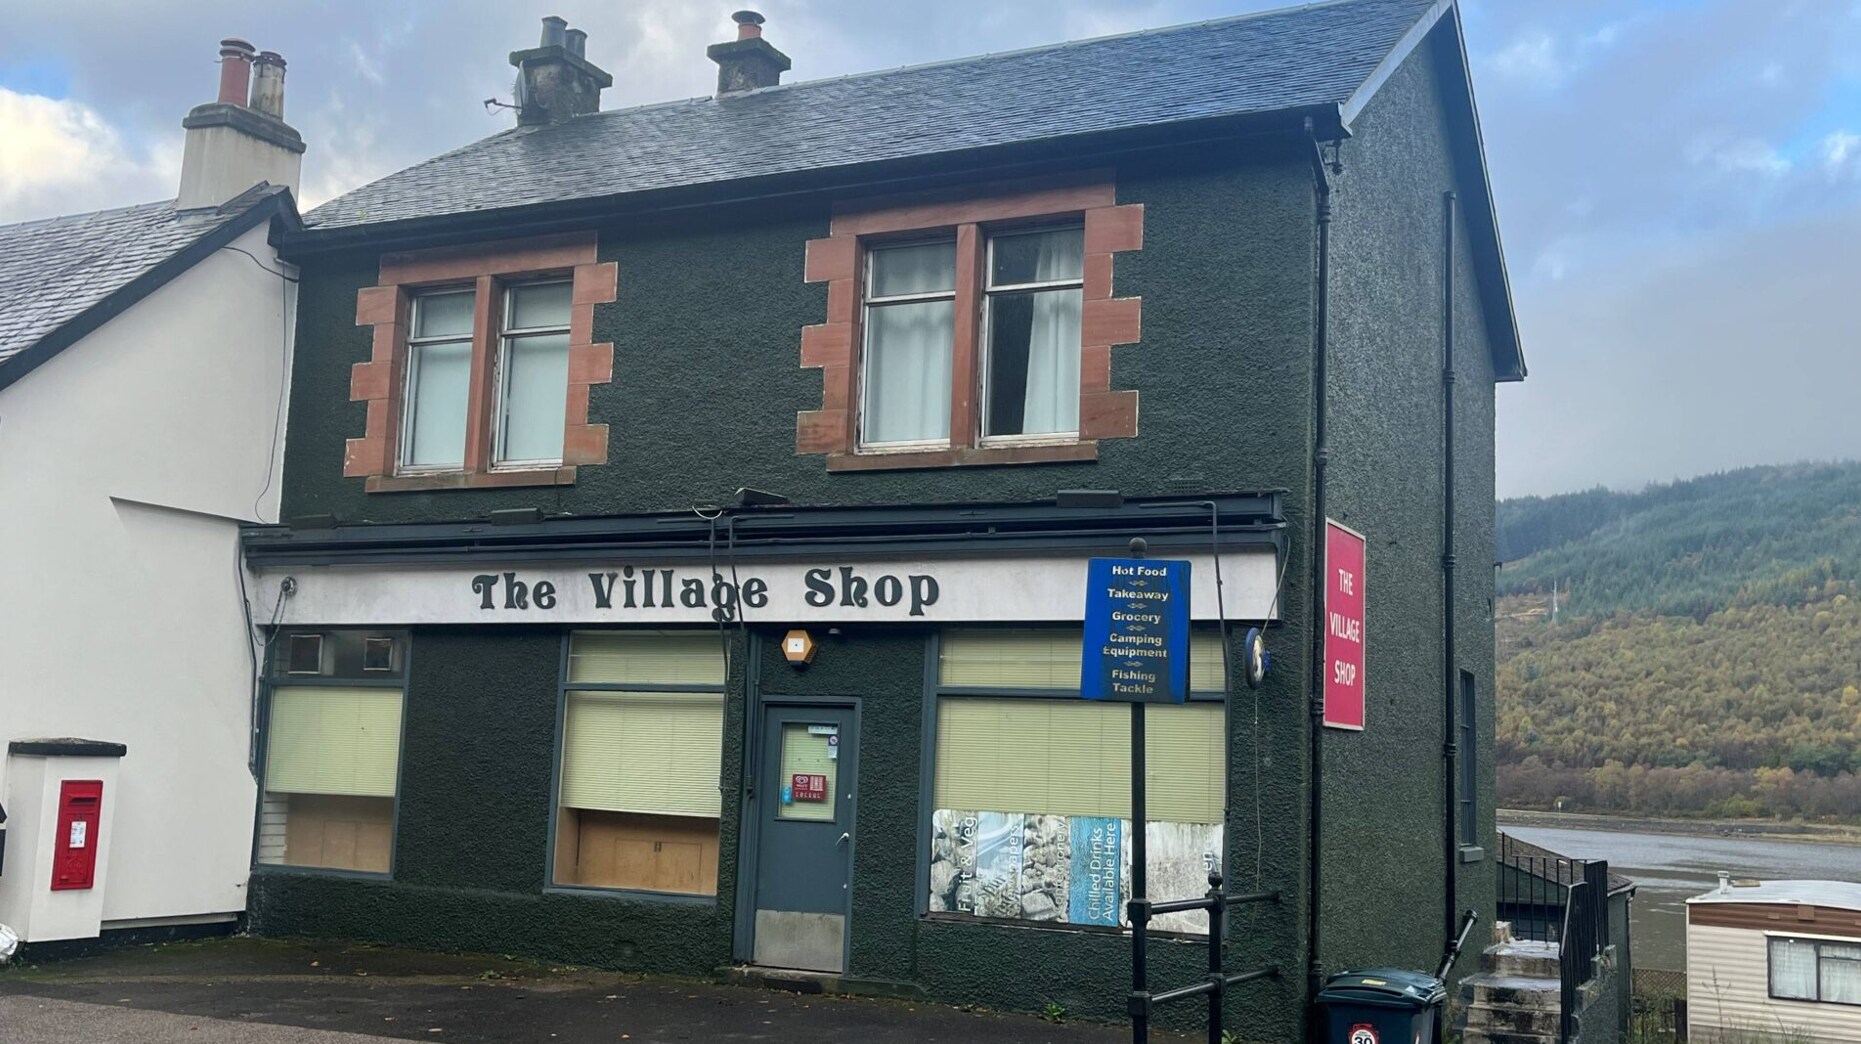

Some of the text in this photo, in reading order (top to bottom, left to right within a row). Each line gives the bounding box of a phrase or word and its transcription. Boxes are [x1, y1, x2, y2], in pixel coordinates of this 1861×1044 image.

[1112, 566, 1167, 576] Hot Food
[1338, 569, 1353, 596] THE
[472, 565, 939, 622] The Village Shop
[1107, 588, 1169, 601] Takeaway
[1112, 611, 1161, 624] Grocery
[1329, 611, 1360, 643] VILLAGE
[1109, 633, 1162, 646] Camping
[1103, 646, 1167, 658] Equipment
[1112, 669, 1156, 682] Fishing
[1334, 659, 1356, 686] SHOP
[1112, 682, 1154, 694] Tackle
[958, 817, 978, 912] Fruit & Veg
[1088, 828, 1102, 920] Chilled Drinks
[1102, 822, 1116, 921] Available Here
